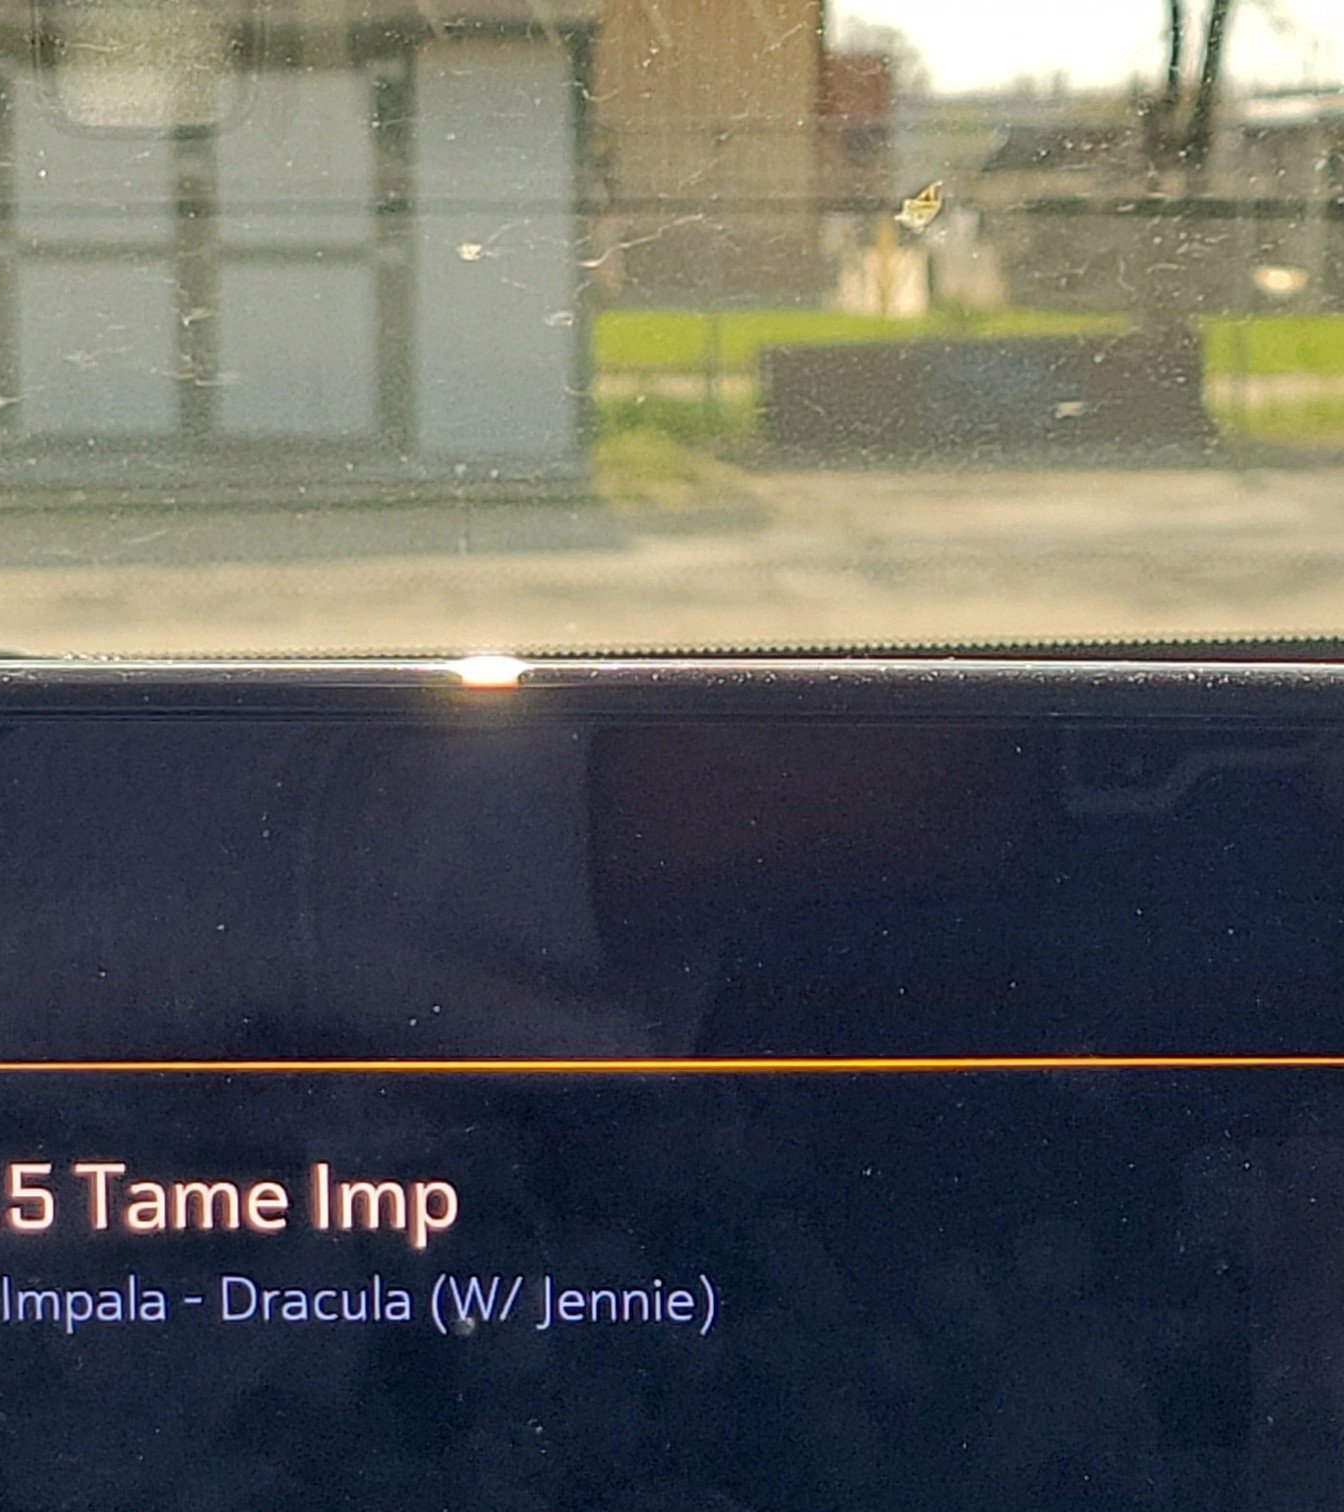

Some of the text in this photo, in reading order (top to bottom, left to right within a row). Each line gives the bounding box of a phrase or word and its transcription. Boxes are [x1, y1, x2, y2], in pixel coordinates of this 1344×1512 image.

[74, 1162, 289, 1232] Tame
[316, 1162, 460, 1250] Imp
[2, 1273, 168, 1335] Impala
[221, 1273, 411, 1322] Dracula
[430, 1273, 524, 1335] (W/
[535, 1273, 715, 1336] Jennie)
